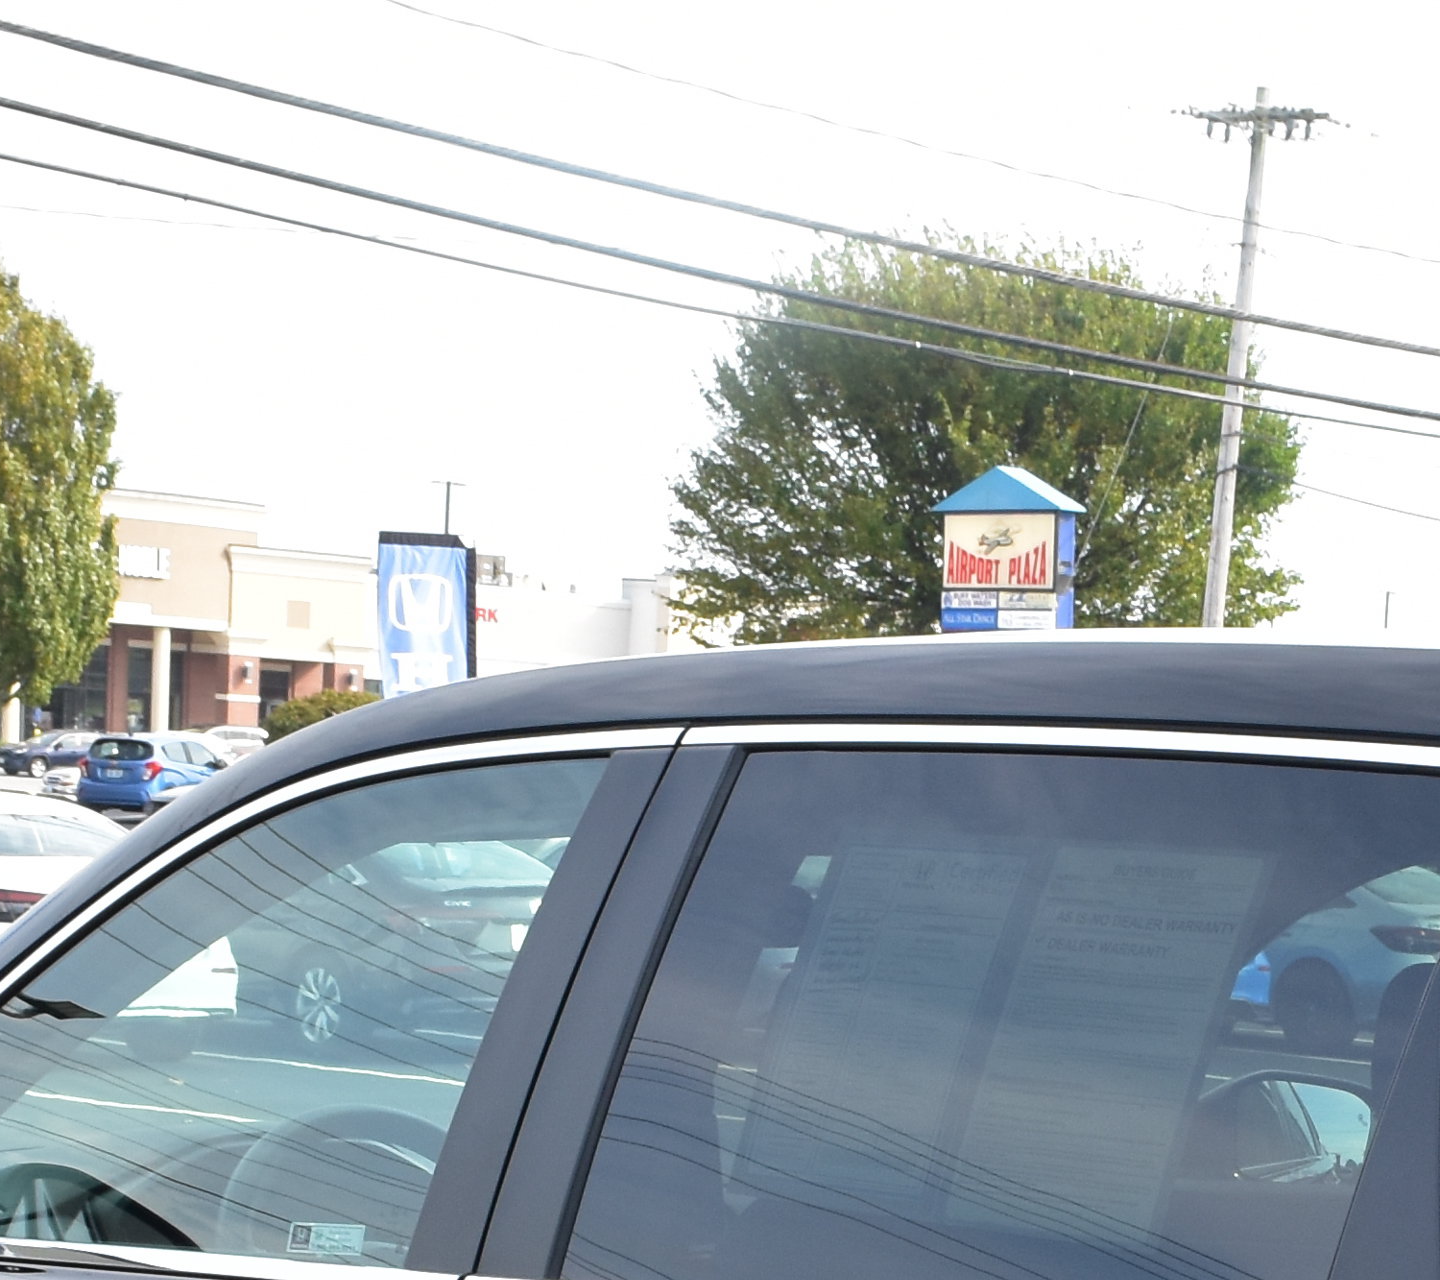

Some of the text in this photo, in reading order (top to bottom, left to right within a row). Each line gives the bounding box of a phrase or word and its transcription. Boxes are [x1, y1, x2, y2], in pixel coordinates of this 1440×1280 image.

[946, 540, 1047, 585] AIRPORT PLAZA
[1112, 914, 1163, 930] DEALER
[1165, 918, 1236, 934] WARRANTY
[1047, 936, 1173, 959] DEALER WARRANTY
